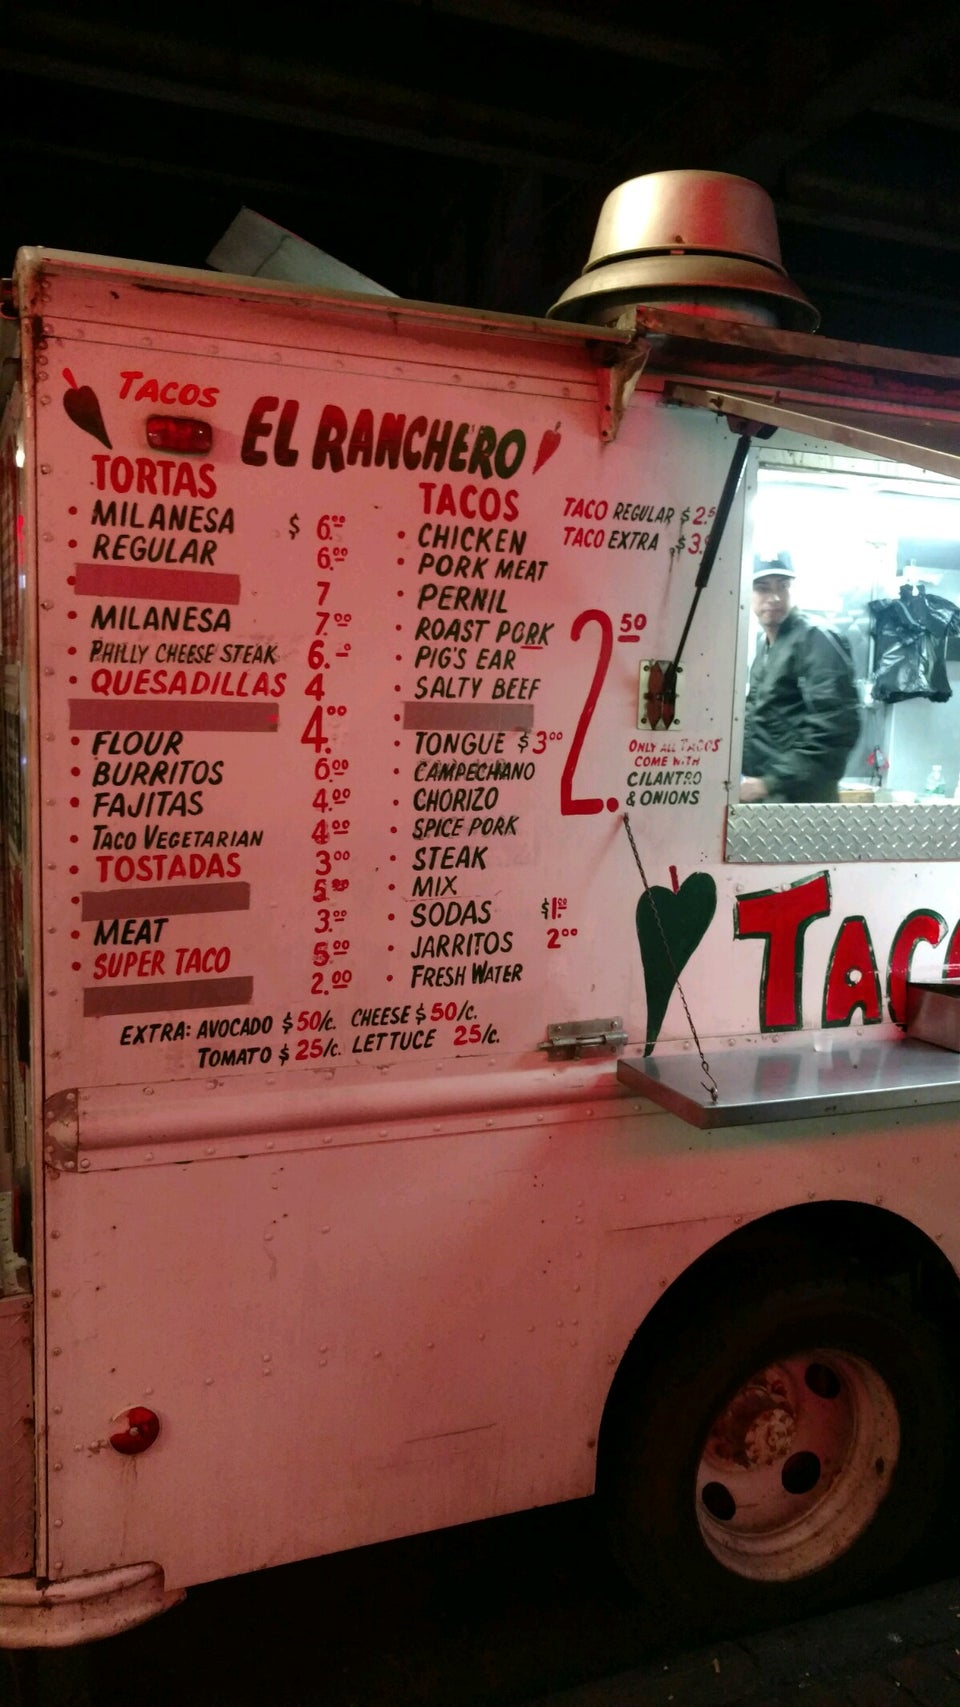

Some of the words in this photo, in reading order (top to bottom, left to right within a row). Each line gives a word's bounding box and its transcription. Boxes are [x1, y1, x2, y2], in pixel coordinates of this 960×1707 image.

[119, 371, 220, 408] TACOS
[241, 396, 299, 467] EL
[312, 404, 527, 480] RANCHERO
[92, 454, 217, 499] TORTAS
[418, 482, 519, 522] TACOS
[562, 497, 609, 521] TACO
[612, 502, 675, 525] REGULAR
[91, 499, 235, 534] MILANESA
[92, 534, 218, 566] REGULAR
[417, 522, 527, 556] CHICKEN
[563, 526, 605, 548] TACO
[607, 530, 659, 551] EXTRA
[418, 552, 489, 580] PORK
[494, 558, 548, 583] MEAT
[316, 581, 331, 606] 7
[417, 583, 508, 613] PERNIL
[90, 605, 231, 632] MILANESA
[414, 616, 491, 643] ROAST
[495, 621, 555, 646] PORK
[89, 640, 150, 665] PHILLY
[155, 643, 215, 664] CHEESE
[219, 643, 279, 665] STEAK
[307, 639, 352, 670] 6.0
[414, 645, 467, 670] PIG'S
[476, 649, 517, 671] EAR
[90, 668, 287, 697] QUESADILLAS
[305, 673, 325, 701] 4
[414, 675, 483, 700] SALTY
[491, 677, 542, 700] BEEF
[91, 730, 184, 756] FLOUR
[415, 731, 506, 757] TONGUE
[629, 739, 657, 753] ONLY
[92, 760, 225, 787] BURRITOS
[413, 759, 536, 782] CAMPECHANO
[634, 756, 668, 767] COME
[627, 771, 702, 787] CILANTRO
[92, 791, 204, 818] FAJITAS
[412, 786, 499, 812] CHORIZO
[626, 791, 636, 807] &
[640, 790, 700, 806] ONIONS
[92, 824, 137, 851] TACO
[144, 824, 264, 850] VEGETARIAN
[412, 817, 465, 840] SPICE
[468, 815, 520, 837] PORK
[95, 852, 241, 883] TOSTADAS
[411, 845, 488, 872] STEAK
[411, 875, 458, 898] MIX
[410, 900, 492, 928] SODAS
[93, 918, 169, 946] MEAT
[410, 931, 514, 959] JARRITOS
[93, 950, 165, 980] SUPER
[175, 946, 232, 976] TACO
[733, 869, 960, 1034] TAC
[410, 964, 466, 989] FRESH
[471, 960, 523, 986] WATER
[120, 1024, 192, 1046] EXTRA:
[196, 1015, 273, 1040] AVOCADO
[351, 1004, 412, 1028] CHEESE
[198, 1045, 272, 1069] TOMATO
[352, 1028, 437, 1054] LETTUCE
